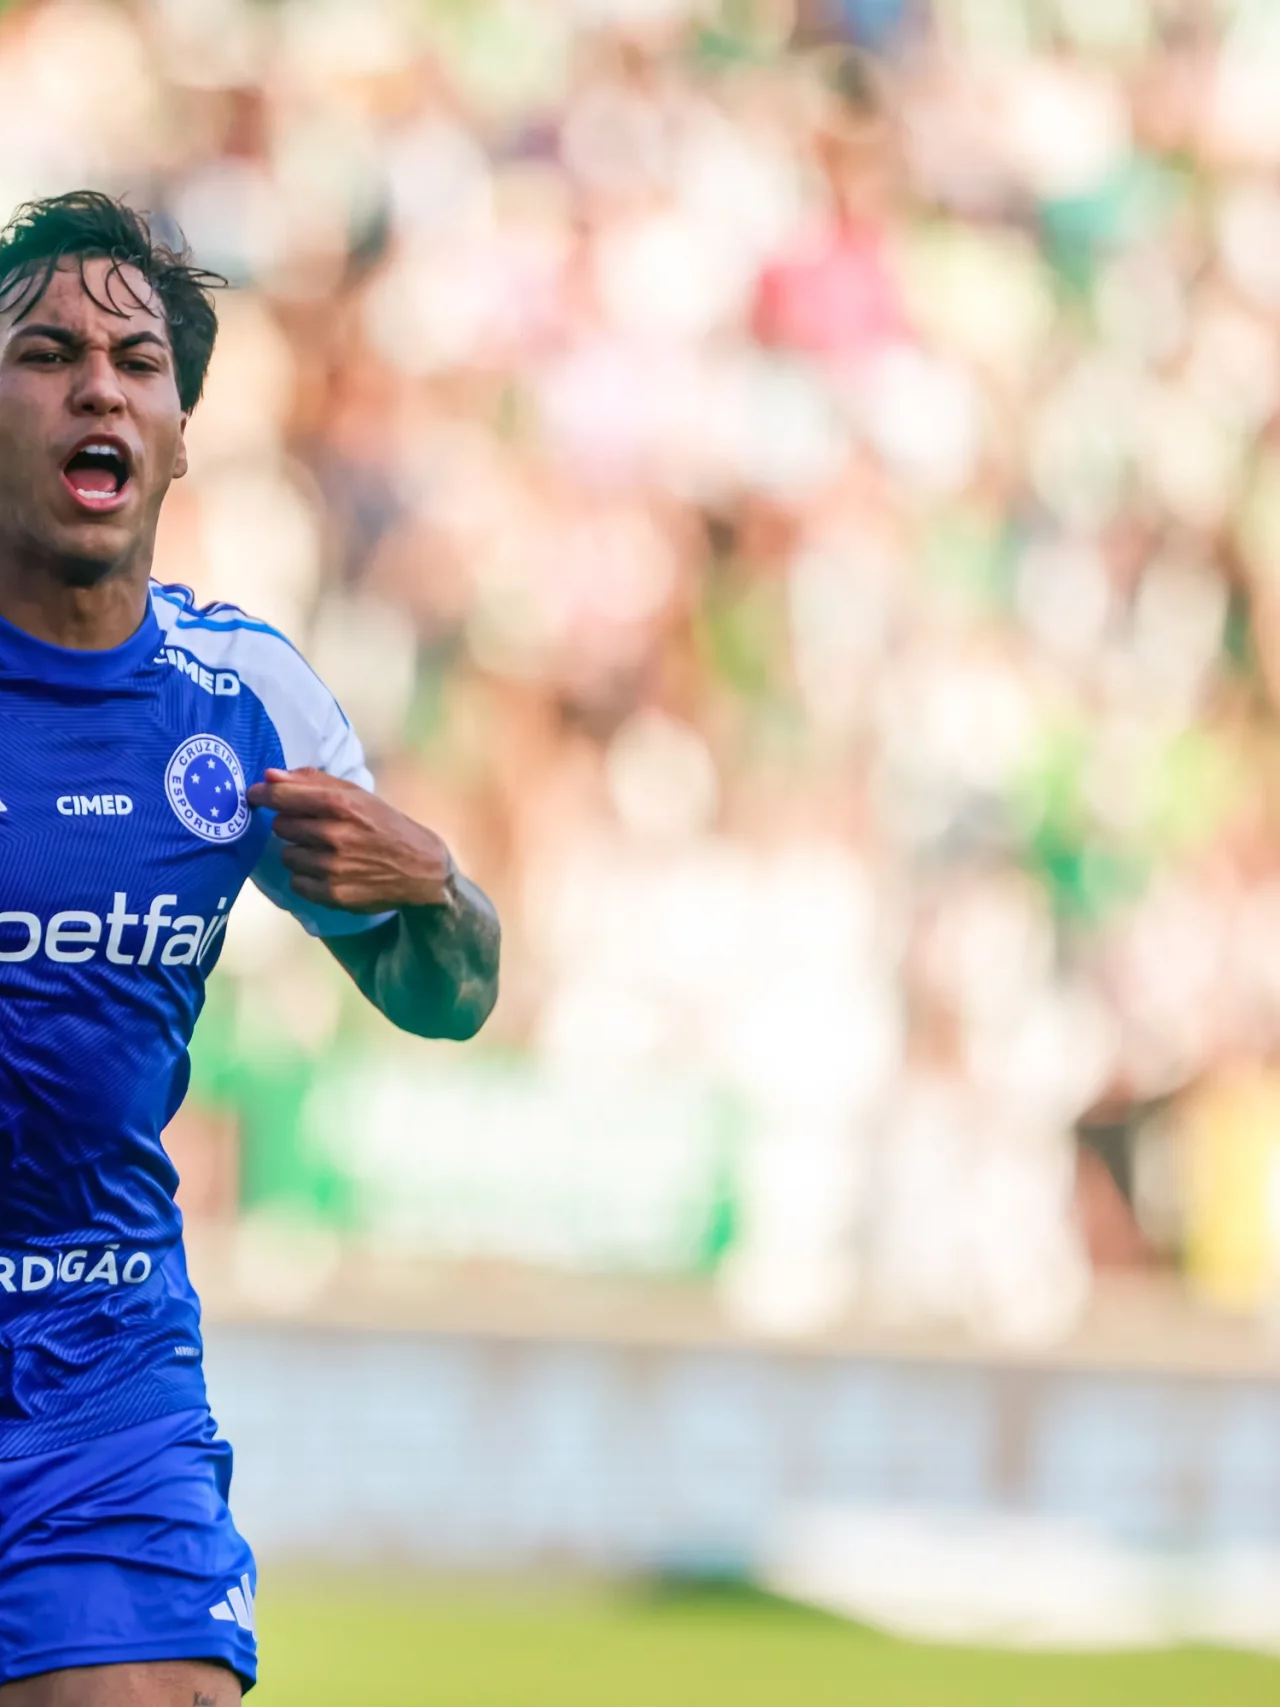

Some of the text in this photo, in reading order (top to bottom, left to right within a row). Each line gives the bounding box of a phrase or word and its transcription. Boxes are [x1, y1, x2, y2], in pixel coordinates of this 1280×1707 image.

[178, 741, 239, 776] CRUZEIRO
[56, 795, 133, 816] CIMED
[171, 775, 221, 836] ESPORTE
